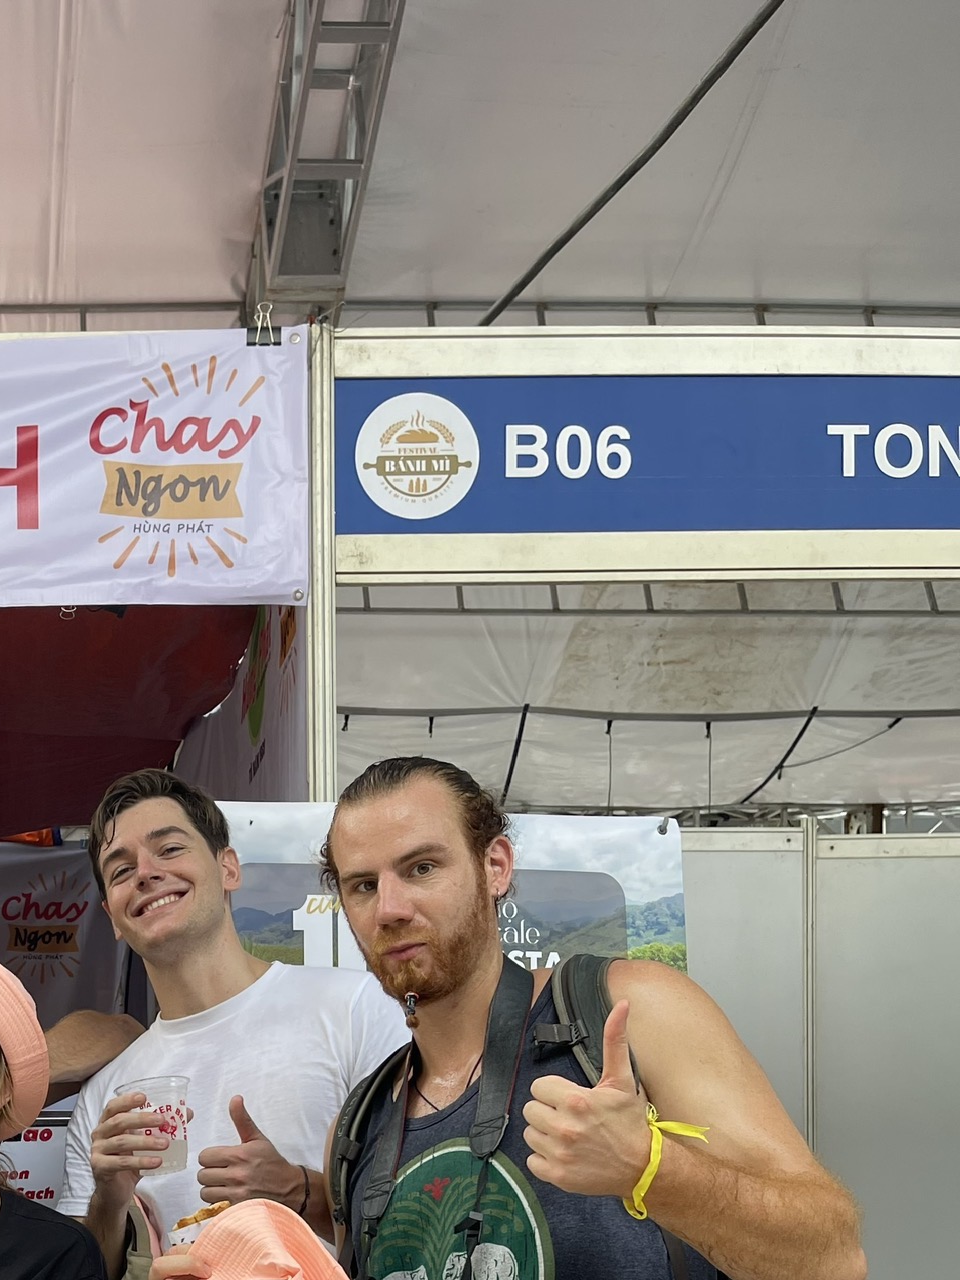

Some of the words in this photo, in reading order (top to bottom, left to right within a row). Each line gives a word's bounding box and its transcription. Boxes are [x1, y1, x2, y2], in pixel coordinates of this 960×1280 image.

[89, 399, 261, 459] Chay
[385, 456, 427, 472] BÁNH
[431, 455, 451, 471] MÌ
[505, 424, 632, 478] B06
[827, 423, 960, 478] TON
[115, 467, 231, 517] Ngon
[133, 520, 170, 533] HÙNG
[177, 520, 213, 533] PHÁT
[1, 893, 88, 922] Chay
[14, 927, 74, 950] Ngon
